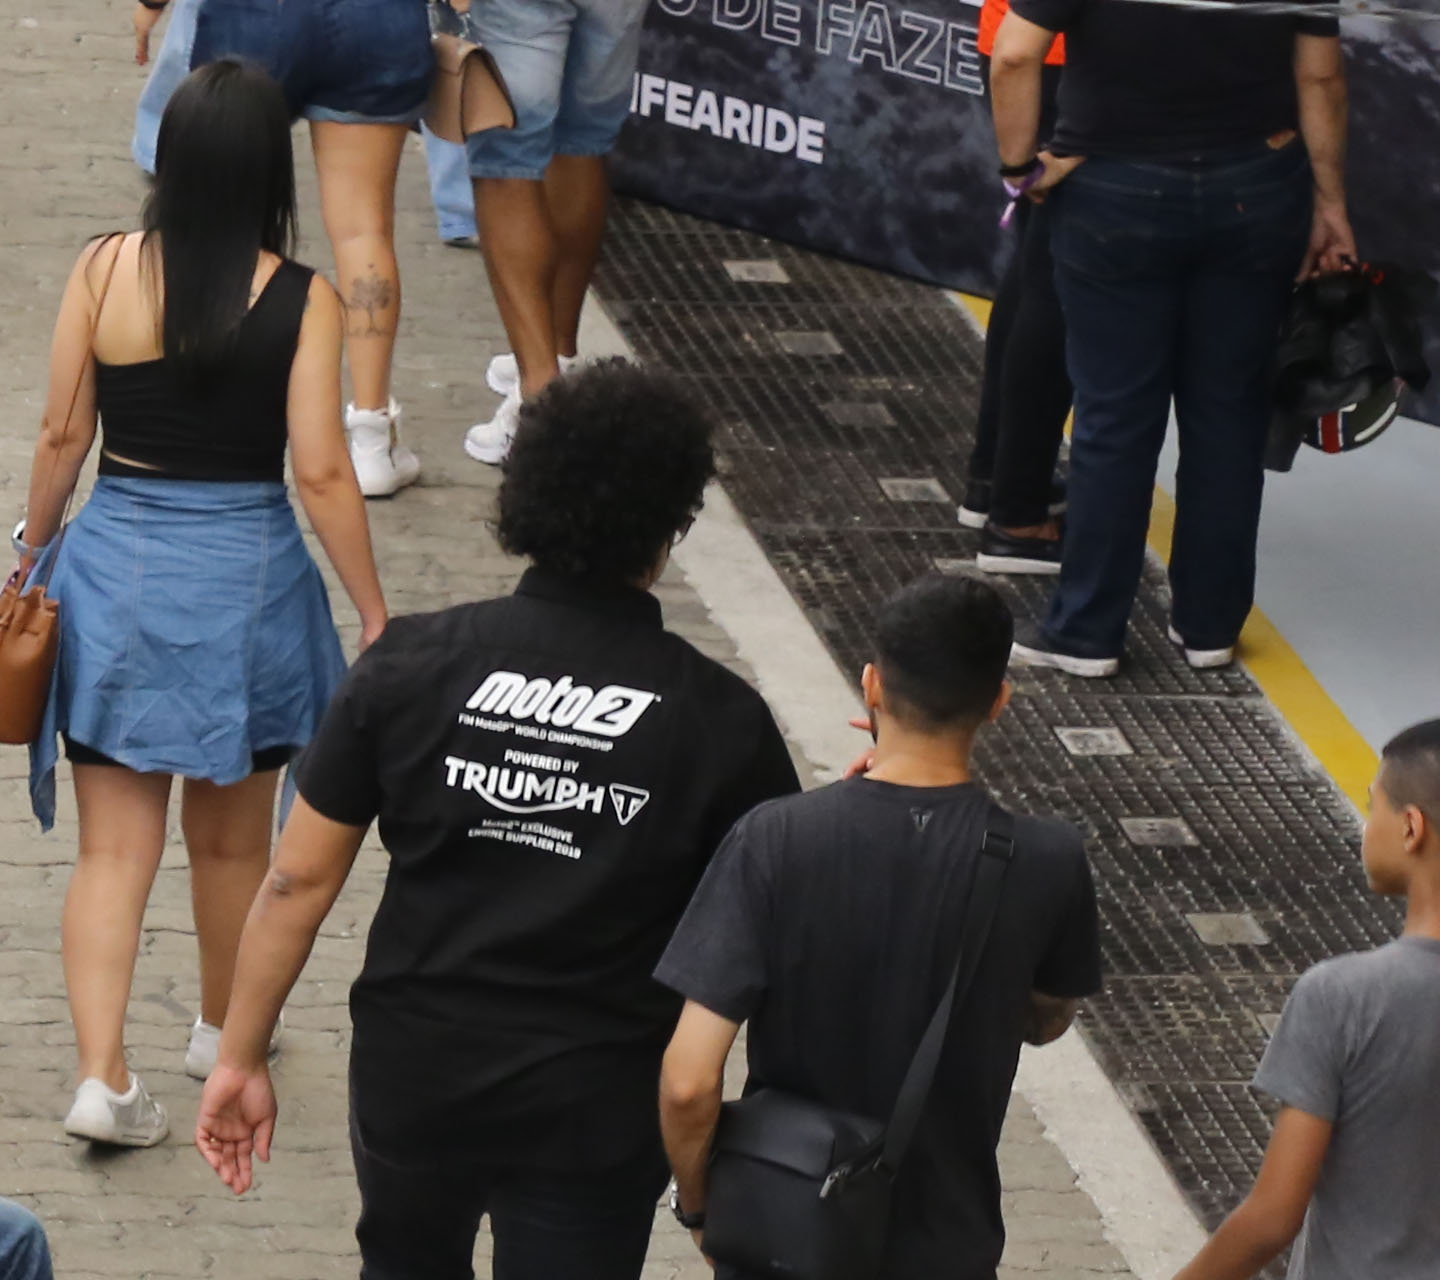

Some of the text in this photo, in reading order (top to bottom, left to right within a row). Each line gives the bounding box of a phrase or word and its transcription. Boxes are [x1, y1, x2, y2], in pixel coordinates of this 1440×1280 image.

[515, 724, 547, 741] WORLD
[548, 731, 614, 752] CHAMPIONSHIP
[504, 749, 579, 774] POWERED BY
[444, 755, 605, 814] TRIUMPH
[506, 831, 554, 852] SUPPLIER
[521, 822, 573, 844] EXCLUSIVE
